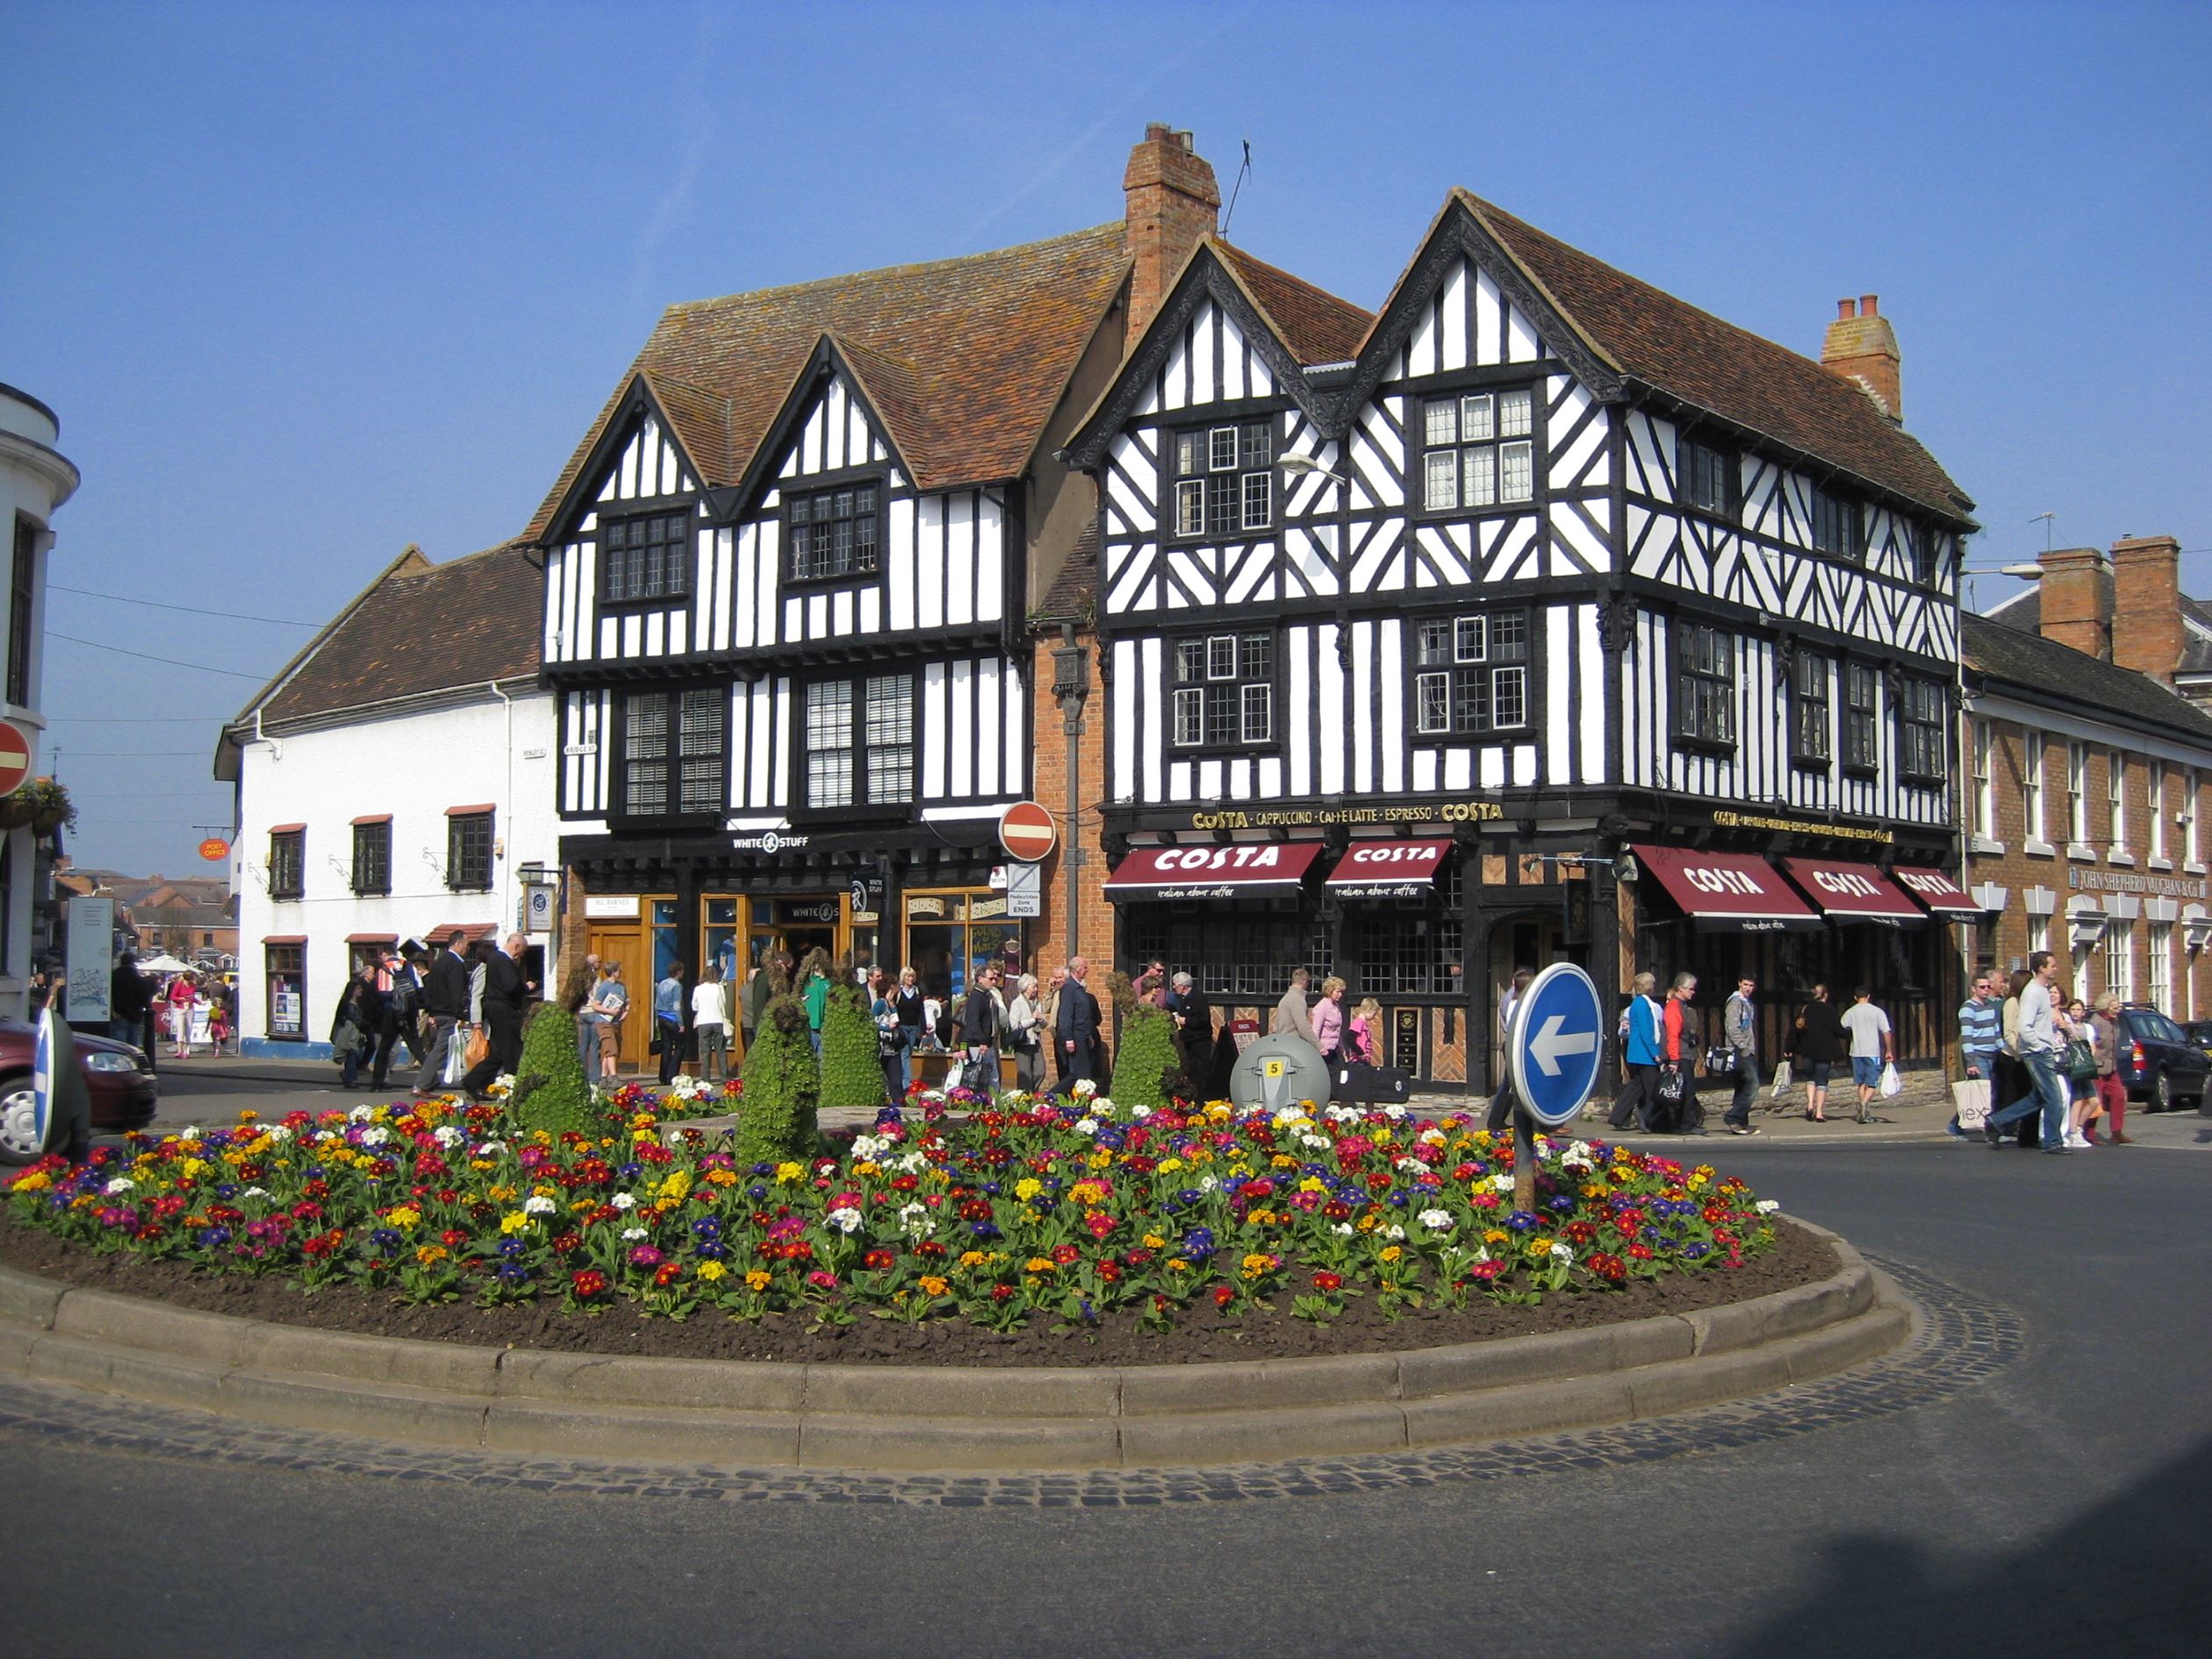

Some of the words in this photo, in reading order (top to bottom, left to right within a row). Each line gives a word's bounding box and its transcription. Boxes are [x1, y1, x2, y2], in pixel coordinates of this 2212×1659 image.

[1192, 811, 1248, 830] COSTA
[1256, 811, 1312, 826] CAPPUCCINO
[1349, 808, 1377, 822] LATTE
[1385, 807, 1432, 821] ESPRESSO
[1441, 802, 1504, 822] COSTA
[733, 838, 762, 849] WHITE
[779, 837, 808, 848] STUFF
[1154, 846, 1279, 870] COSTA
[1354, 846, 1436, 863] COSTA
[1684, 867, 1765, 894] COSTA
[1813, 871, 1883, 897] COSTA
[1898, 872, 1960, 895] COSTA
[2079, 870, 2103, 890] JOHN
[2104, 873, 2145, 892] SHEPHERD
[2146, 876, 2181, 896] VAUGHAN
[2181, 880, 2188, 896] &
[1187, 886, 1210, 897] about
[1210, 885, 1234, 898] coffee
[1367, 883, 1391, 896] about
[1393, 883, 1418, 896] coffee
[793, 908, 819, 916] WHITE
[1270, 1063, 1278, 1074] 5
[1959, 1107, 1989, 1121] nex
